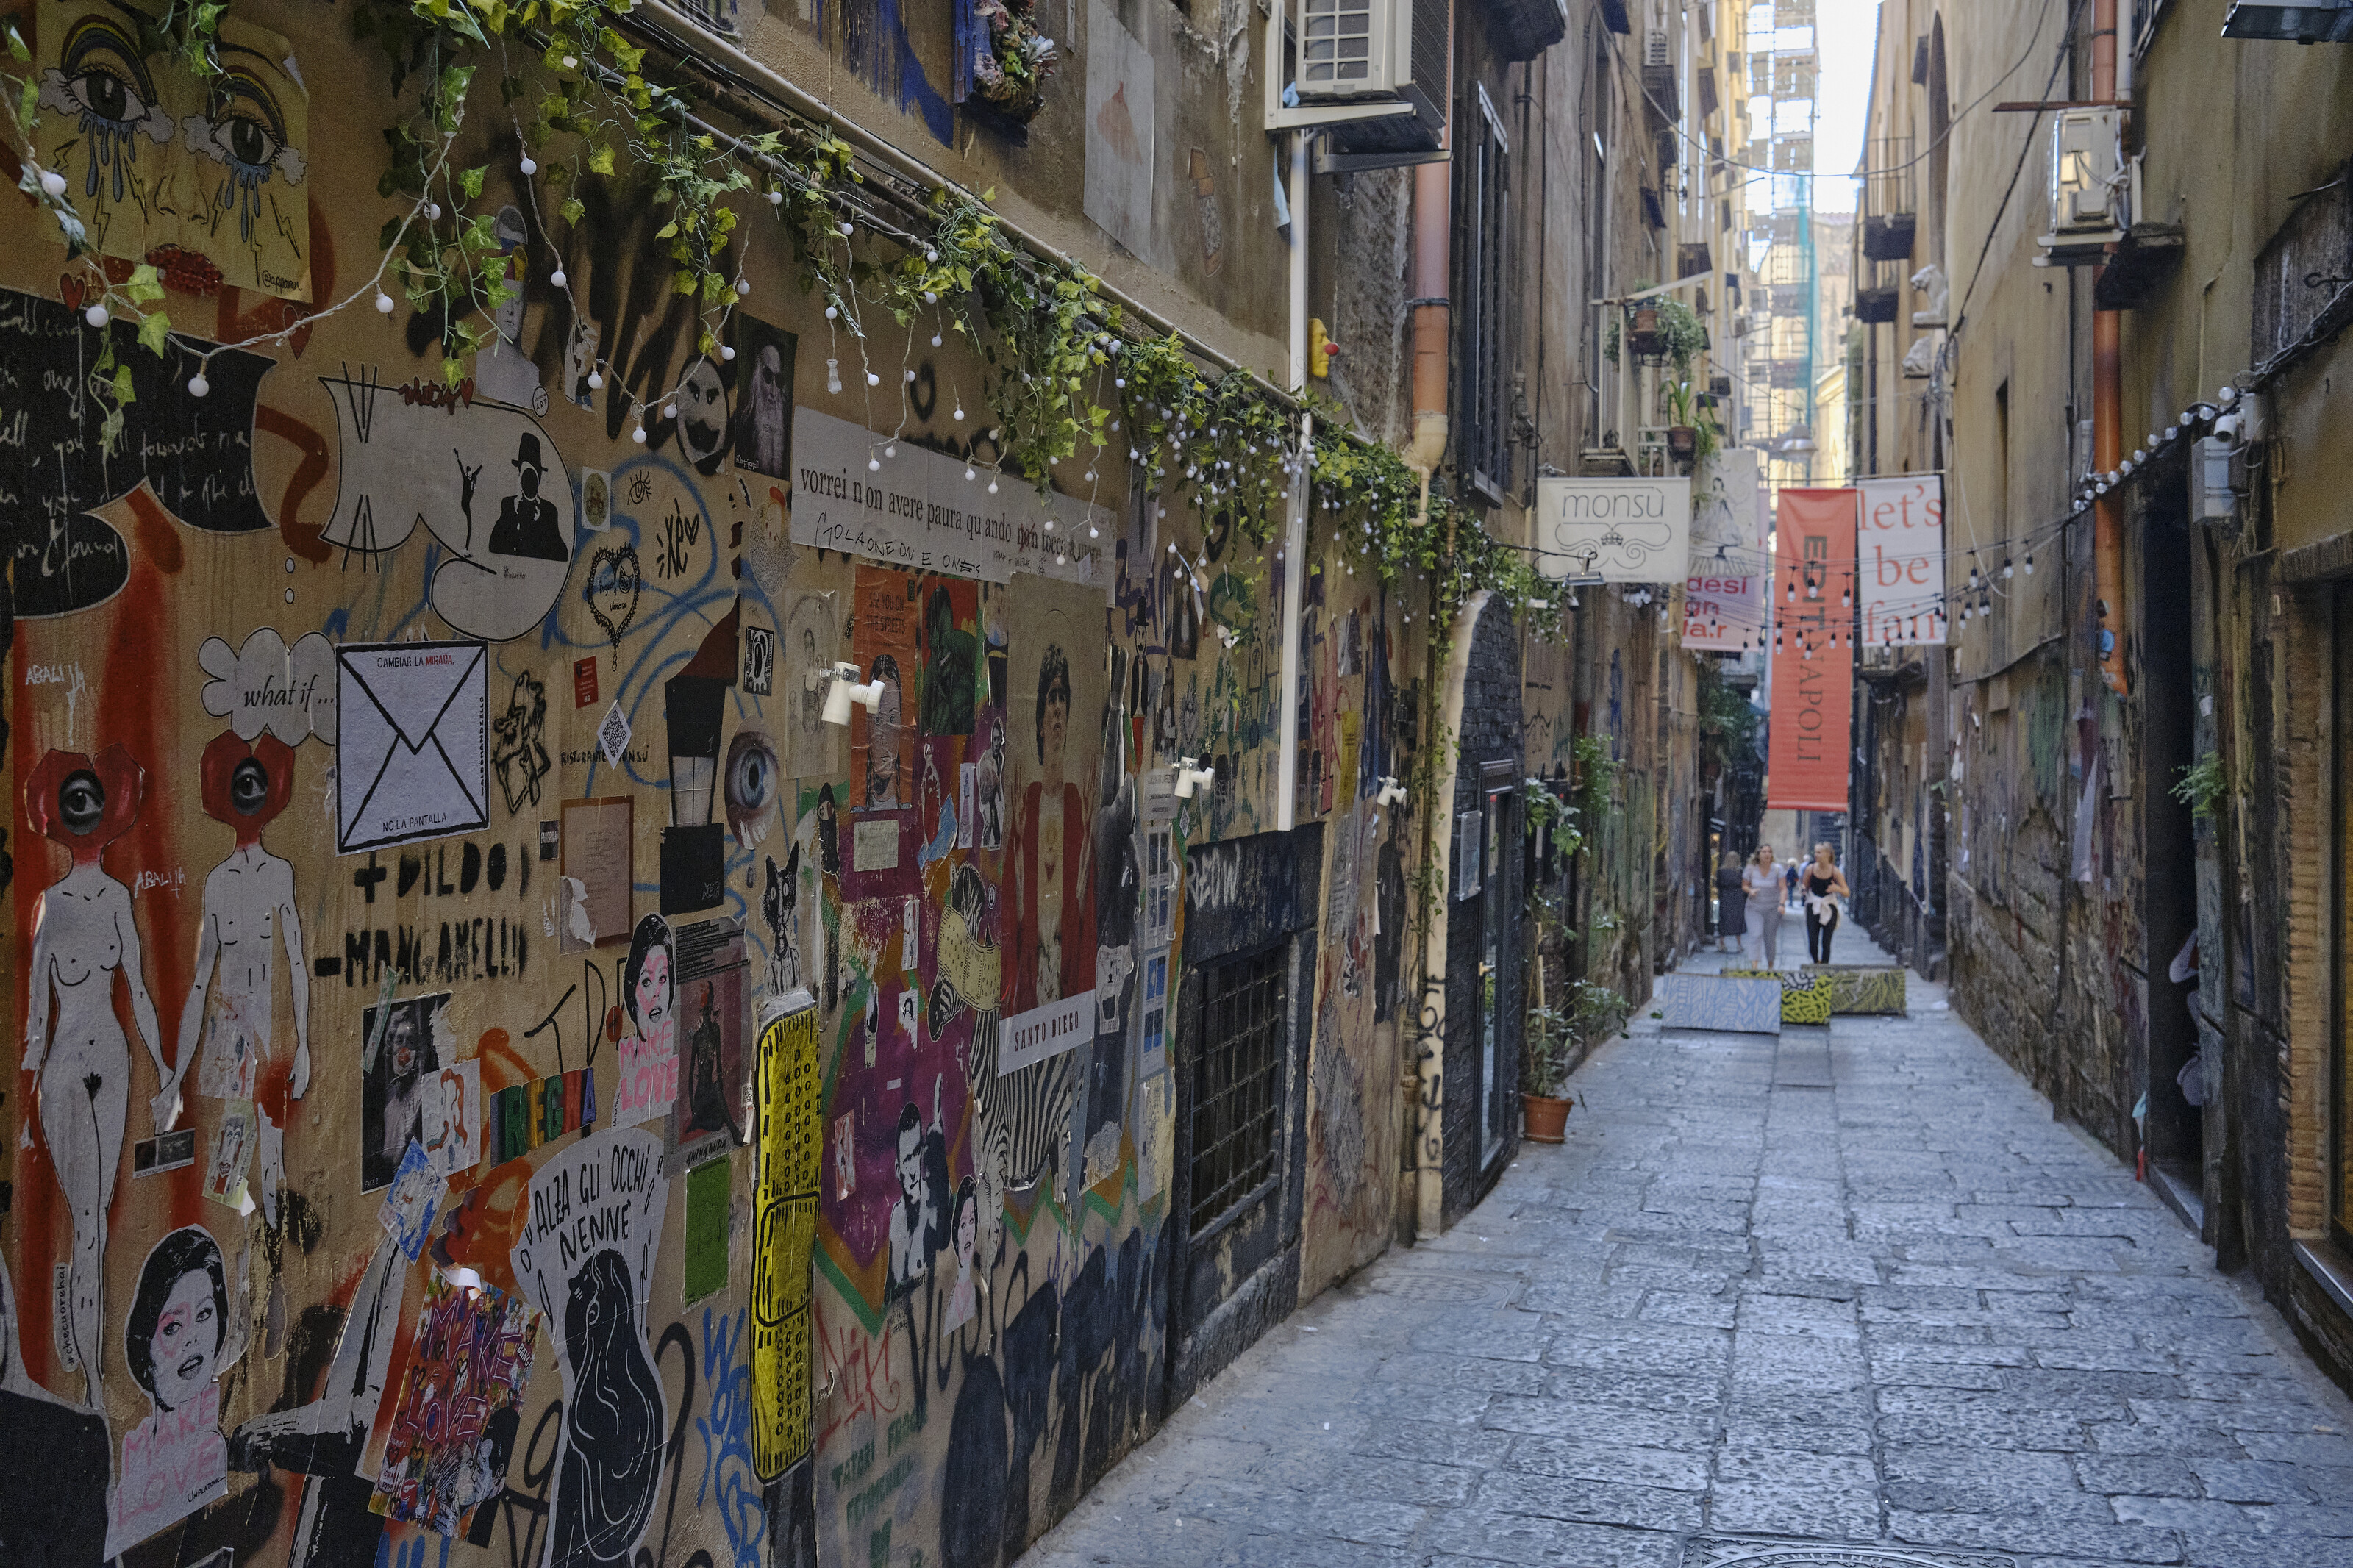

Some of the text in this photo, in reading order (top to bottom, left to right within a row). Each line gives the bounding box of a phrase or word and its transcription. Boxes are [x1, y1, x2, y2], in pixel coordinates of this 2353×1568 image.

[800, 467, 846, 501] vorrei
[888, 493, 924, 520] avere
[926, 501, 962, 531] paura
[1563, 488, 1664, 518] monsù
[1874, 537, 1929, 587] be
[1687, 576, 1747, 595] desi
[377, 656, 413, 669] CAMBIAR
[414, 656, 424, 667] LA
[243, 674, 296, 708] what
[382, 812, 447, 833] NO LA PANTALLA
[618, 1017, 673, 1068] MAKE
[1014, 1010, 1079, 1052] SANTO DIEGO
[619, 1056, 679, 1111] LOVE
[406, 1376, 487, 1442] LOVE
